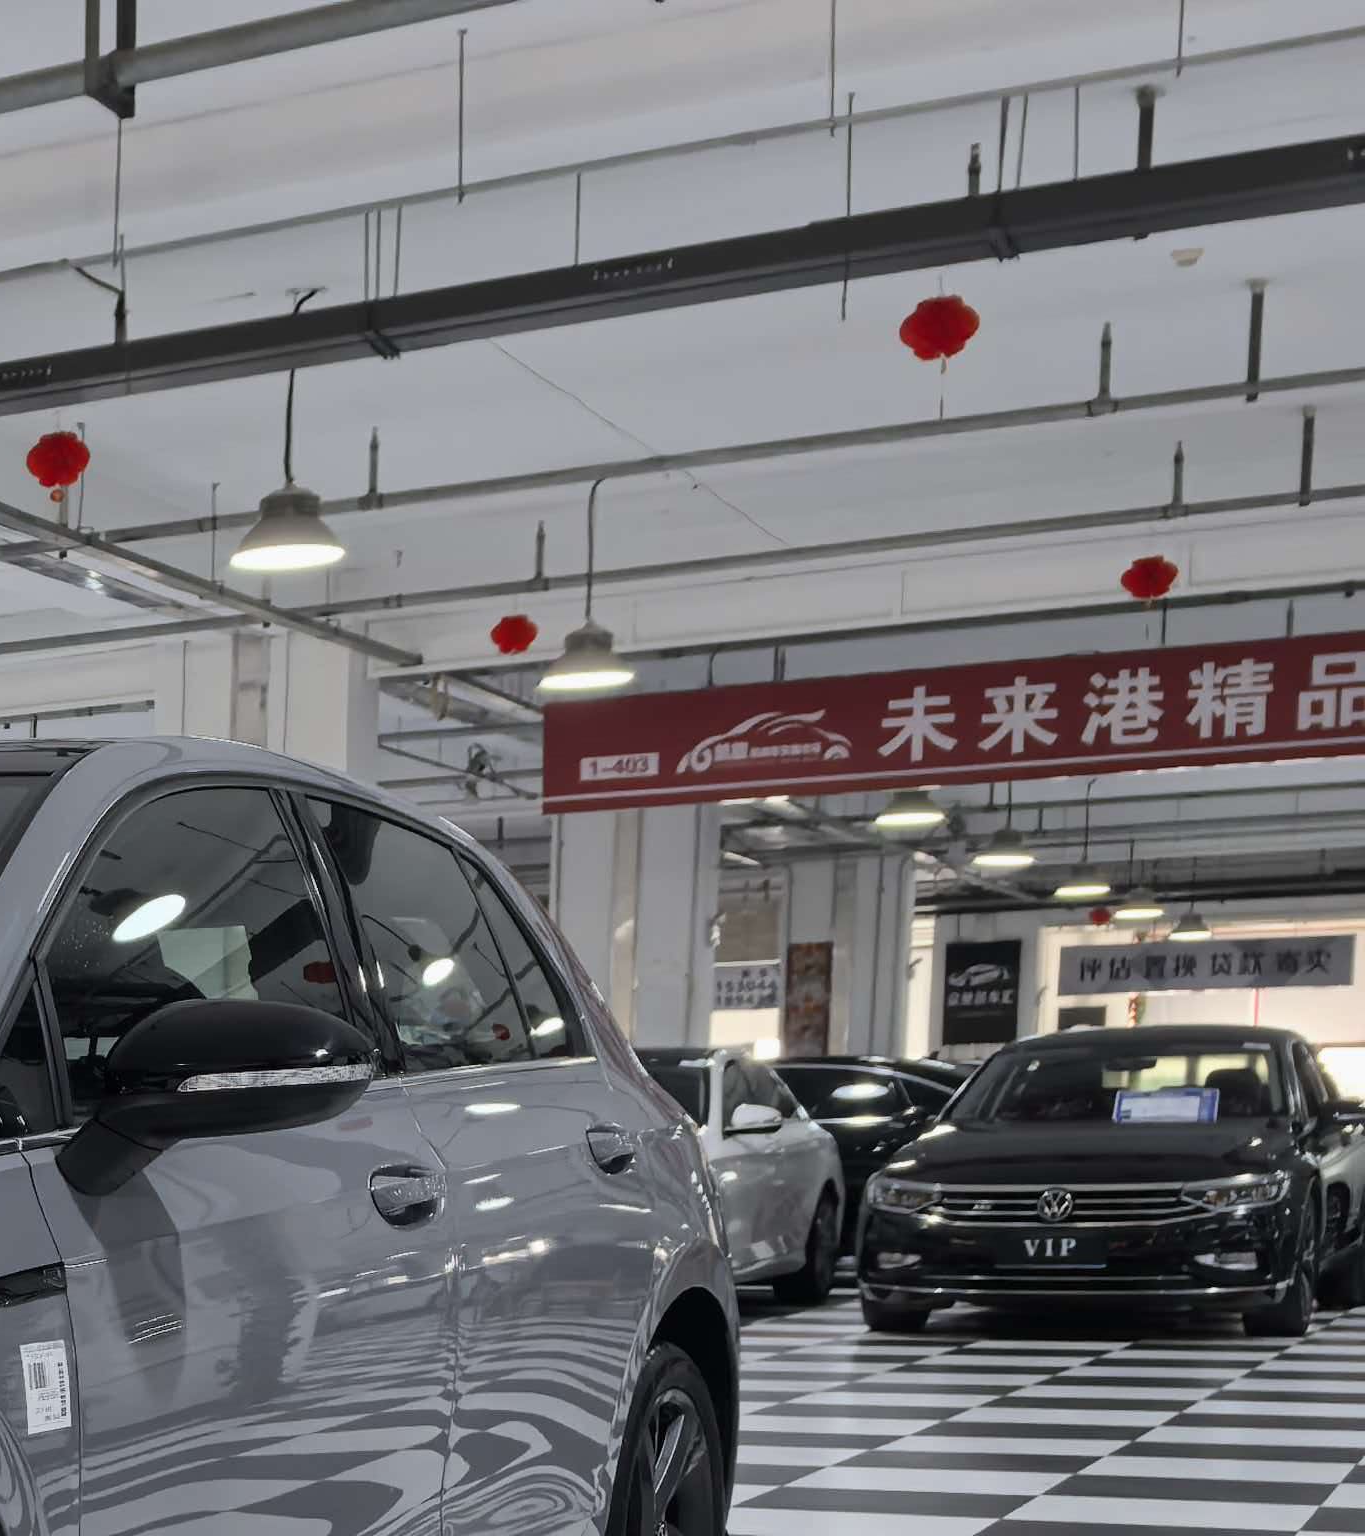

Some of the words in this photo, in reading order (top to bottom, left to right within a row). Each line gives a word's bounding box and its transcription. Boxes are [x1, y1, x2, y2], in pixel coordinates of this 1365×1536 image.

[877, 650, 1365, 762] 未来港精品
[588, 755, 650, 777] 1-403
[1023, 1238, 1077, 1257] VIP
